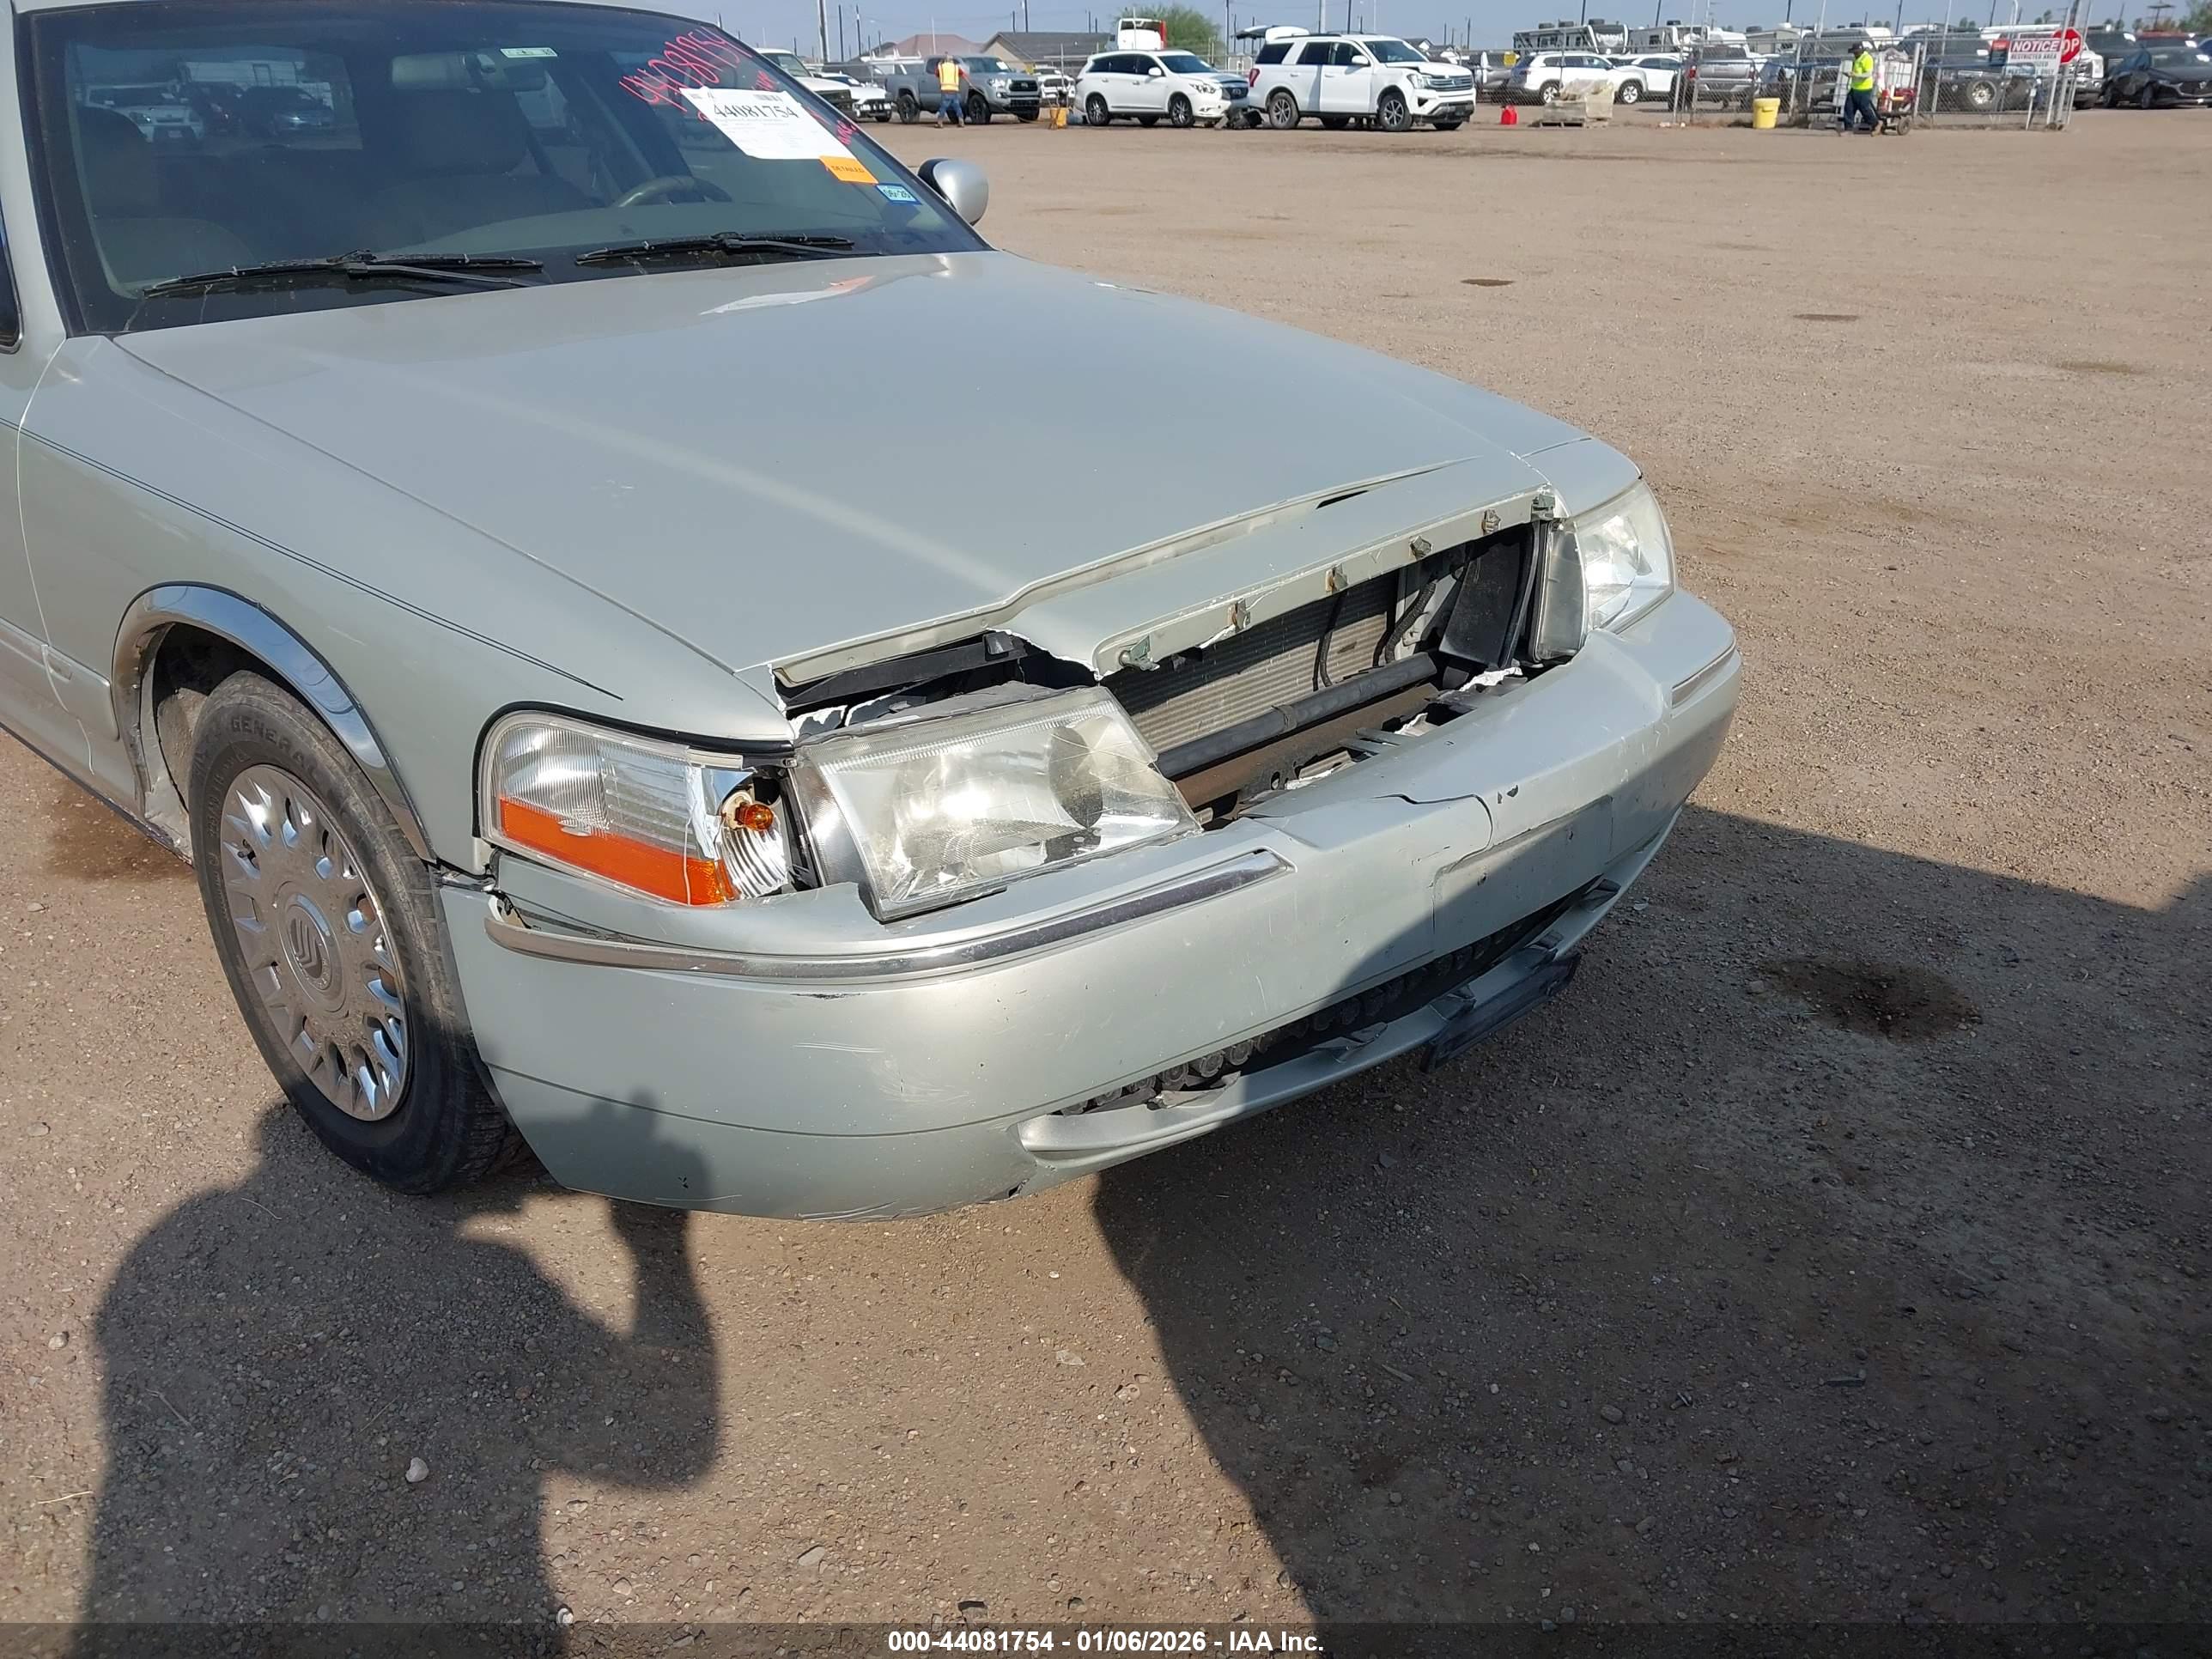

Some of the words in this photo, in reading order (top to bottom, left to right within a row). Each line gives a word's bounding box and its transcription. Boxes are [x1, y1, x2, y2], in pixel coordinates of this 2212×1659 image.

[2013, 40, 2058, 52] NOTICE
[2063, 39, 2080, 53] OP
[714, 104, 799, 118] 44081754
